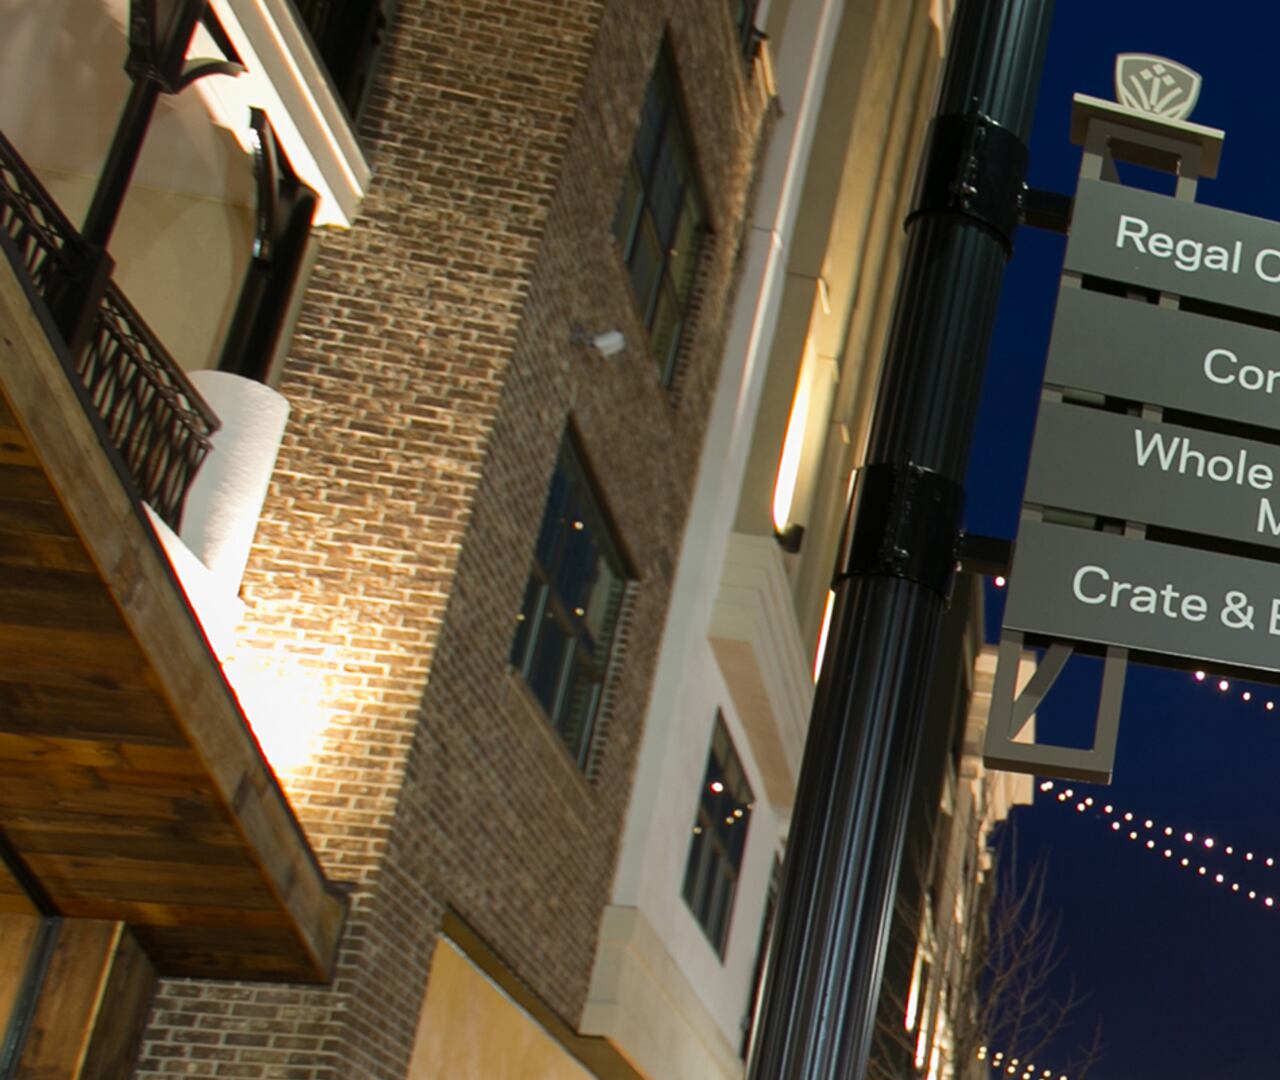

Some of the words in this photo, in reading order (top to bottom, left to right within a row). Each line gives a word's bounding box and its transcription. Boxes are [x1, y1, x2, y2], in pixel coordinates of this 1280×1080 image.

[1115, 214, 1243, 272] Regal
[1134, 428, 1274, 491] Whole
[1072, 564, 1208, 622] Crate
[1219, 590, 1256, 631] &
